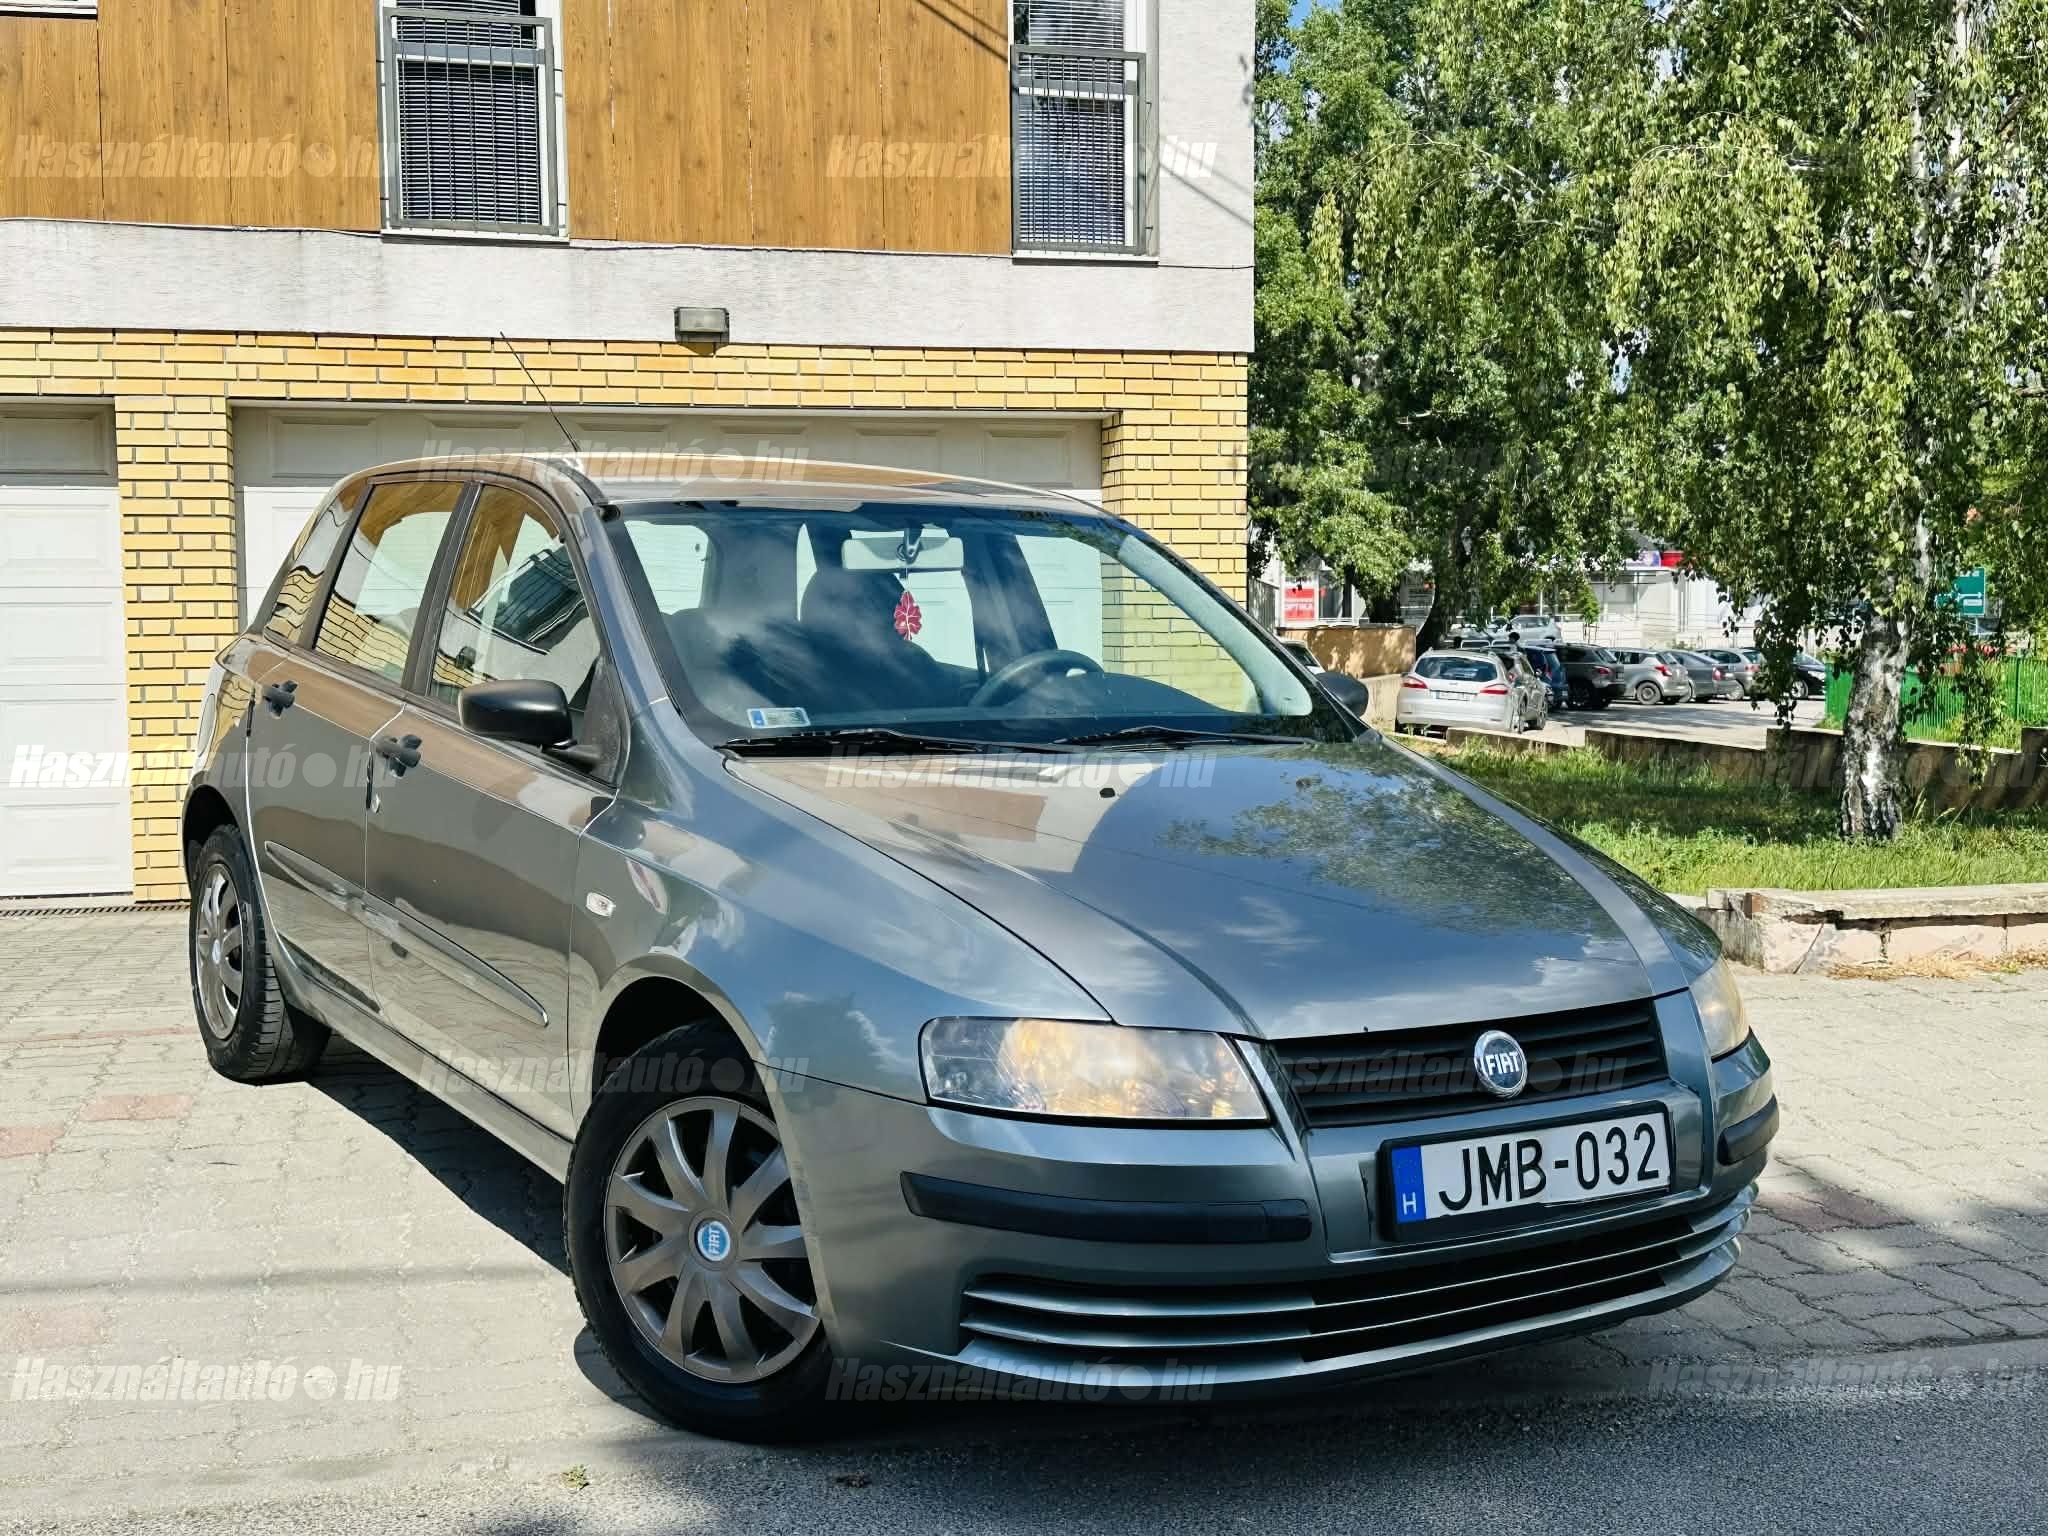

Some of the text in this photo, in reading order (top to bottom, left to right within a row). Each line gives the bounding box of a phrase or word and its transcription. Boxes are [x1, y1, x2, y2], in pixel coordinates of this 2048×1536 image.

[1485, 1051, 1520, 1076] FIAT
[1438, 1122, 1660, 1211] JMB-032
[1402, 1191, 1418, 1216] H
[707, 1229, 721, 1255] FIAT
